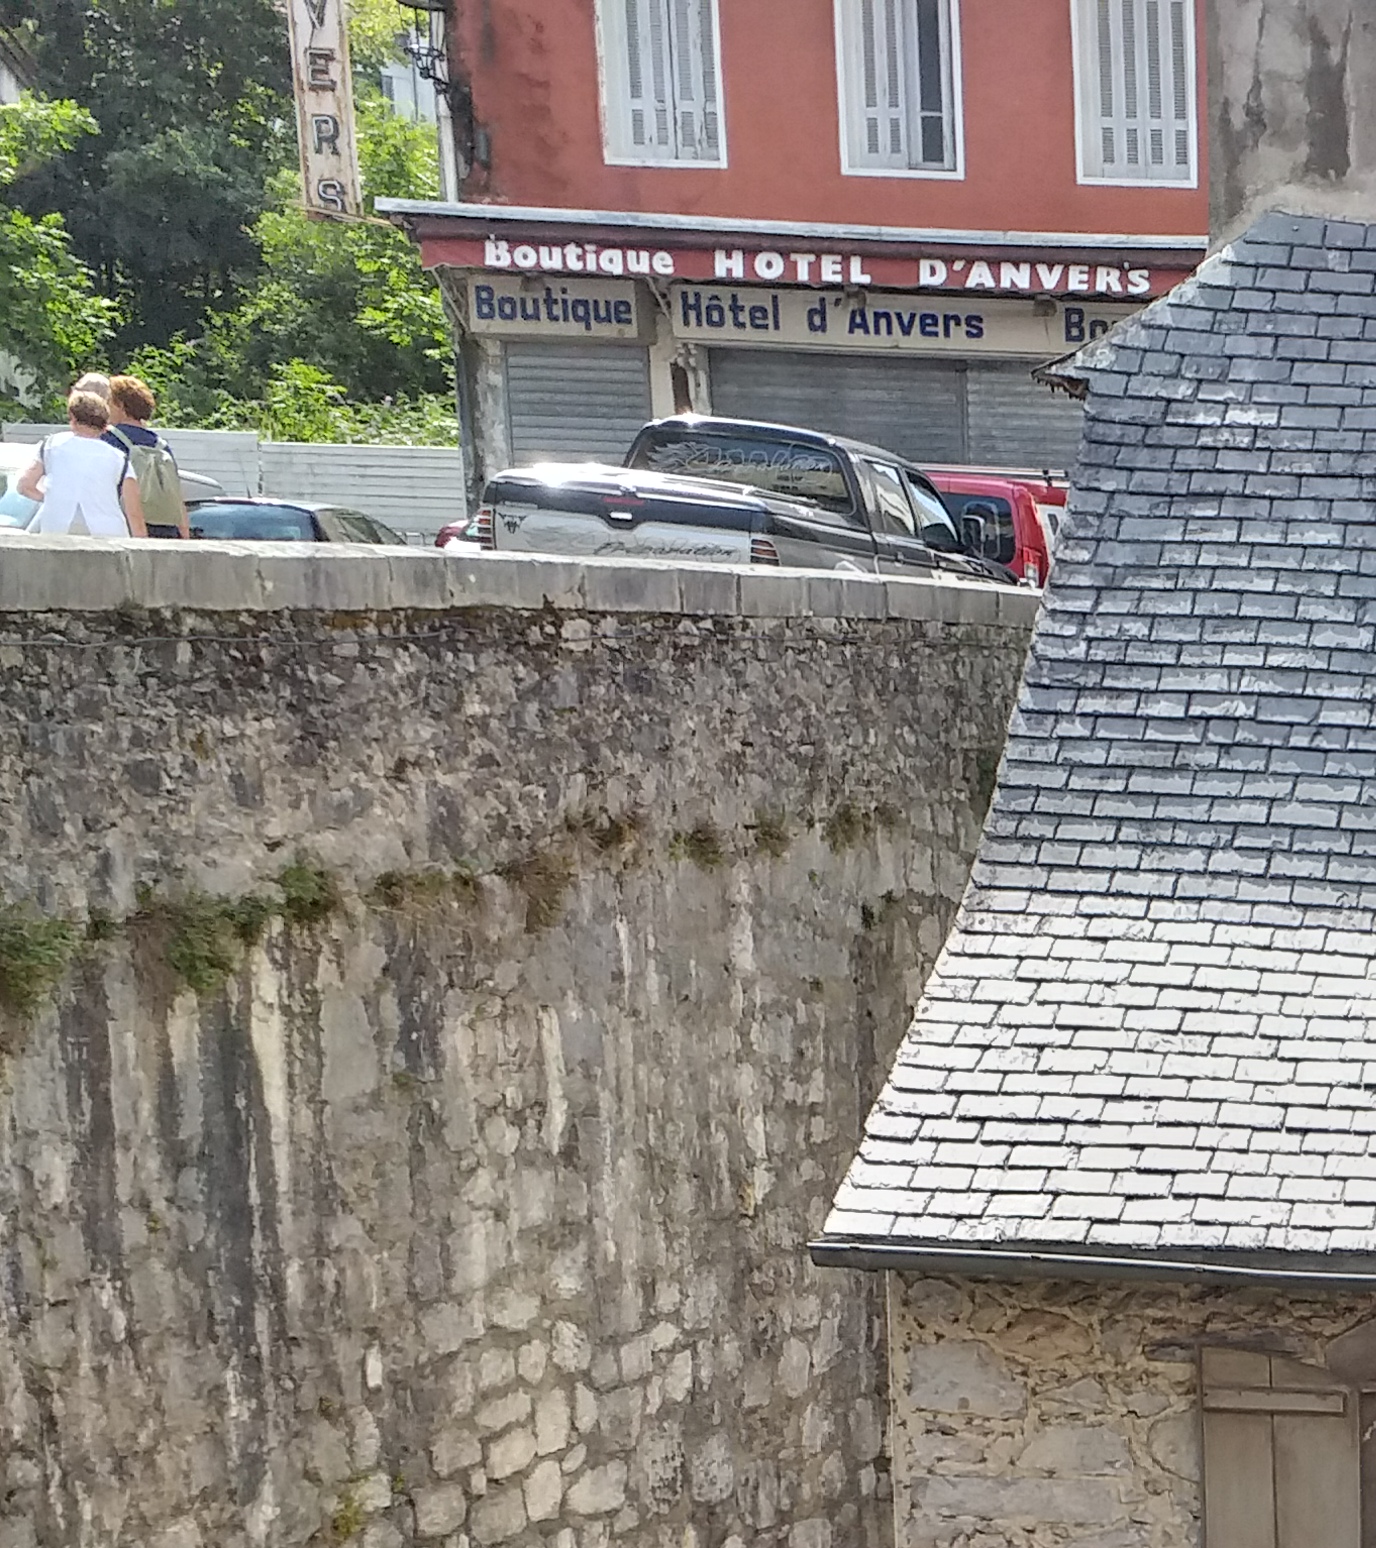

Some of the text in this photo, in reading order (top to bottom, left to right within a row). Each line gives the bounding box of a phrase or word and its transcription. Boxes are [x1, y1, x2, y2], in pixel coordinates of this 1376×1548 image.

[484, 238, 1151, 295] Boutique HOTEL D'ANVERS
[474, 284, 632, 331] Boutique
[680, 291, 985, 340] Hôtel d'Anvers
